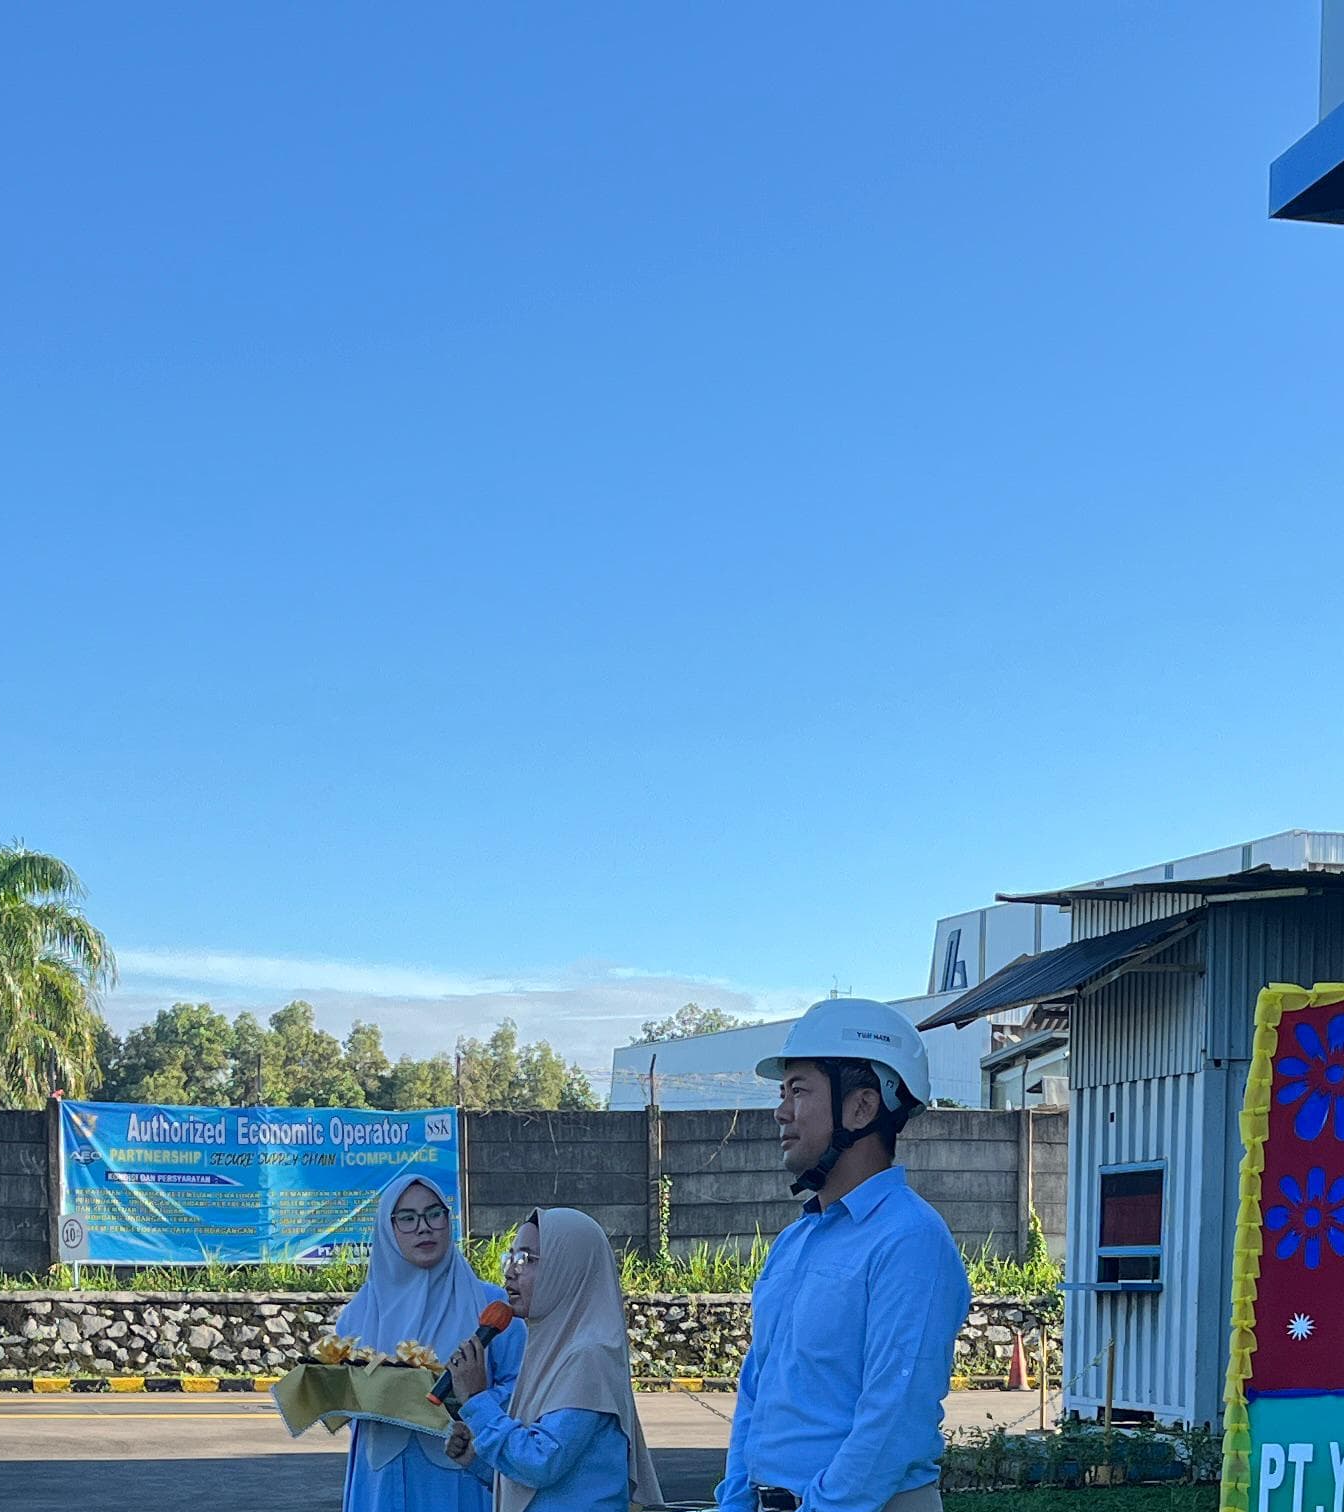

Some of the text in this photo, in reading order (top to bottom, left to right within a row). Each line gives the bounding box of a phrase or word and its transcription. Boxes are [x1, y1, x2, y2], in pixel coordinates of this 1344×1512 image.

[127, 1112, 409, 1151] Authorized Economic Operator
[427, 1119, 450, 1136] SSK
[71, 1151, 102, 1161] AEO
[110, 1148, 202, 1164] PARTNERSHIP
[209, 1152, 255, 1168] SECURE
[302, 1151, 337, 1167] CHAIN
[345, 1147, 438, 1167] COMPLIANCE
[65, 1228, 76, 1242] 10
